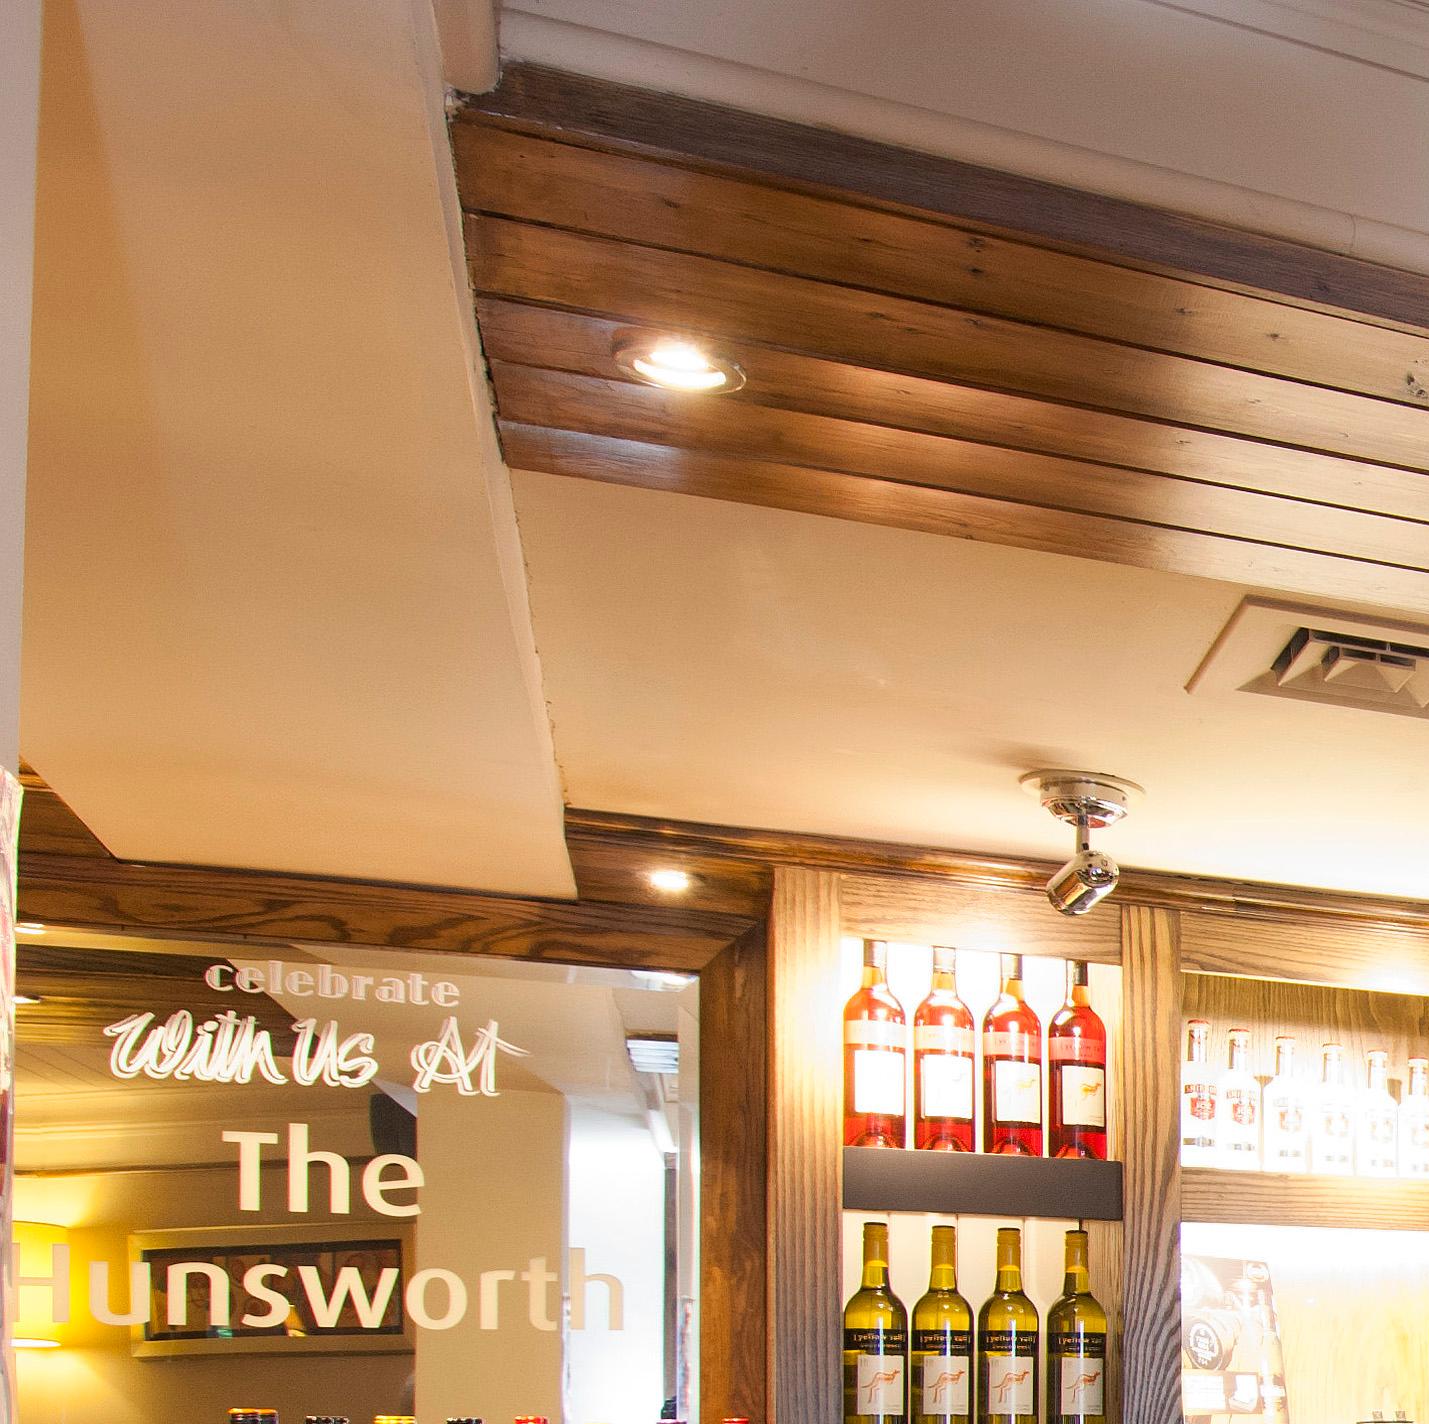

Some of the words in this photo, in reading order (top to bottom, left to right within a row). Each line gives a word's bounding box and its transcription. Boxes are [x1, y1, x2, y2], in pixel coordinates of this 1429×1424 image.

[205, 960, 460, 1008] celebrate
[103, 1009, 289, 1085] With
[291, 1017, 378, 1088] Us
[410, 1015, 530, 1097] At
[222, 1122, 425, 1218] The
[12, 1241, 626, 1332] Hunsworth
